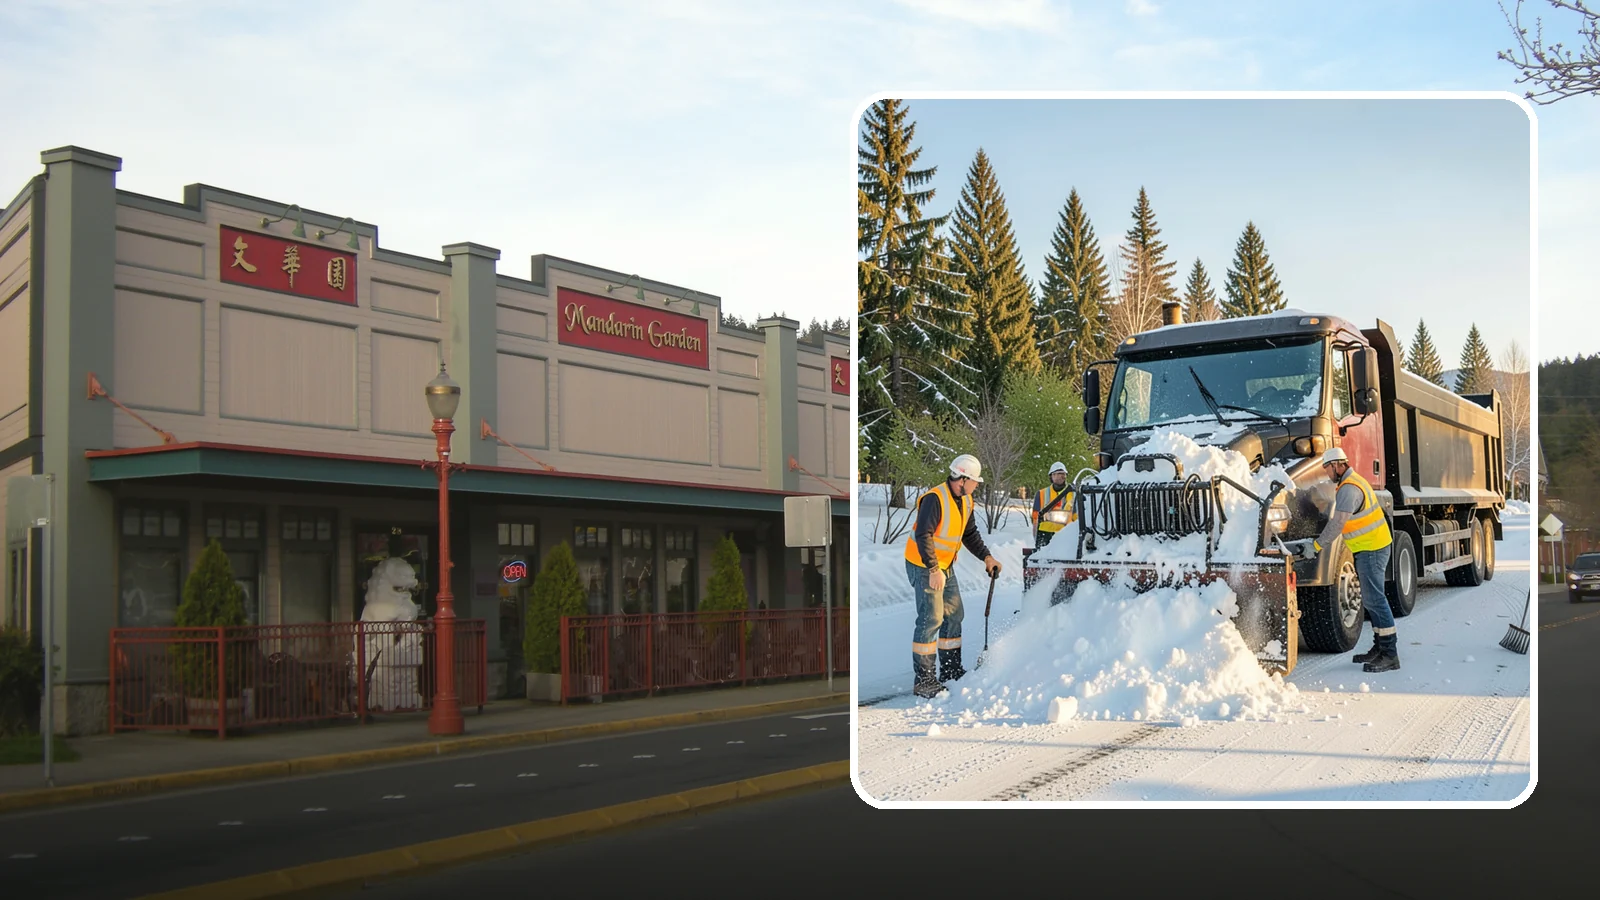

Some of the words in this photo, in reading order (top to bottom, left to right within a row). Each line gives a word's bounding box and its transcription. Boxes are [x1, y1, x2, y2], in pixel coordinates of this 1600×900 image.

[230, 235, 346, 291] 文華園
[564, 303, 644, 340] Mandarin
[648, 320, 701, 352] Garden
[503, 565, 527, 578] OPEN
